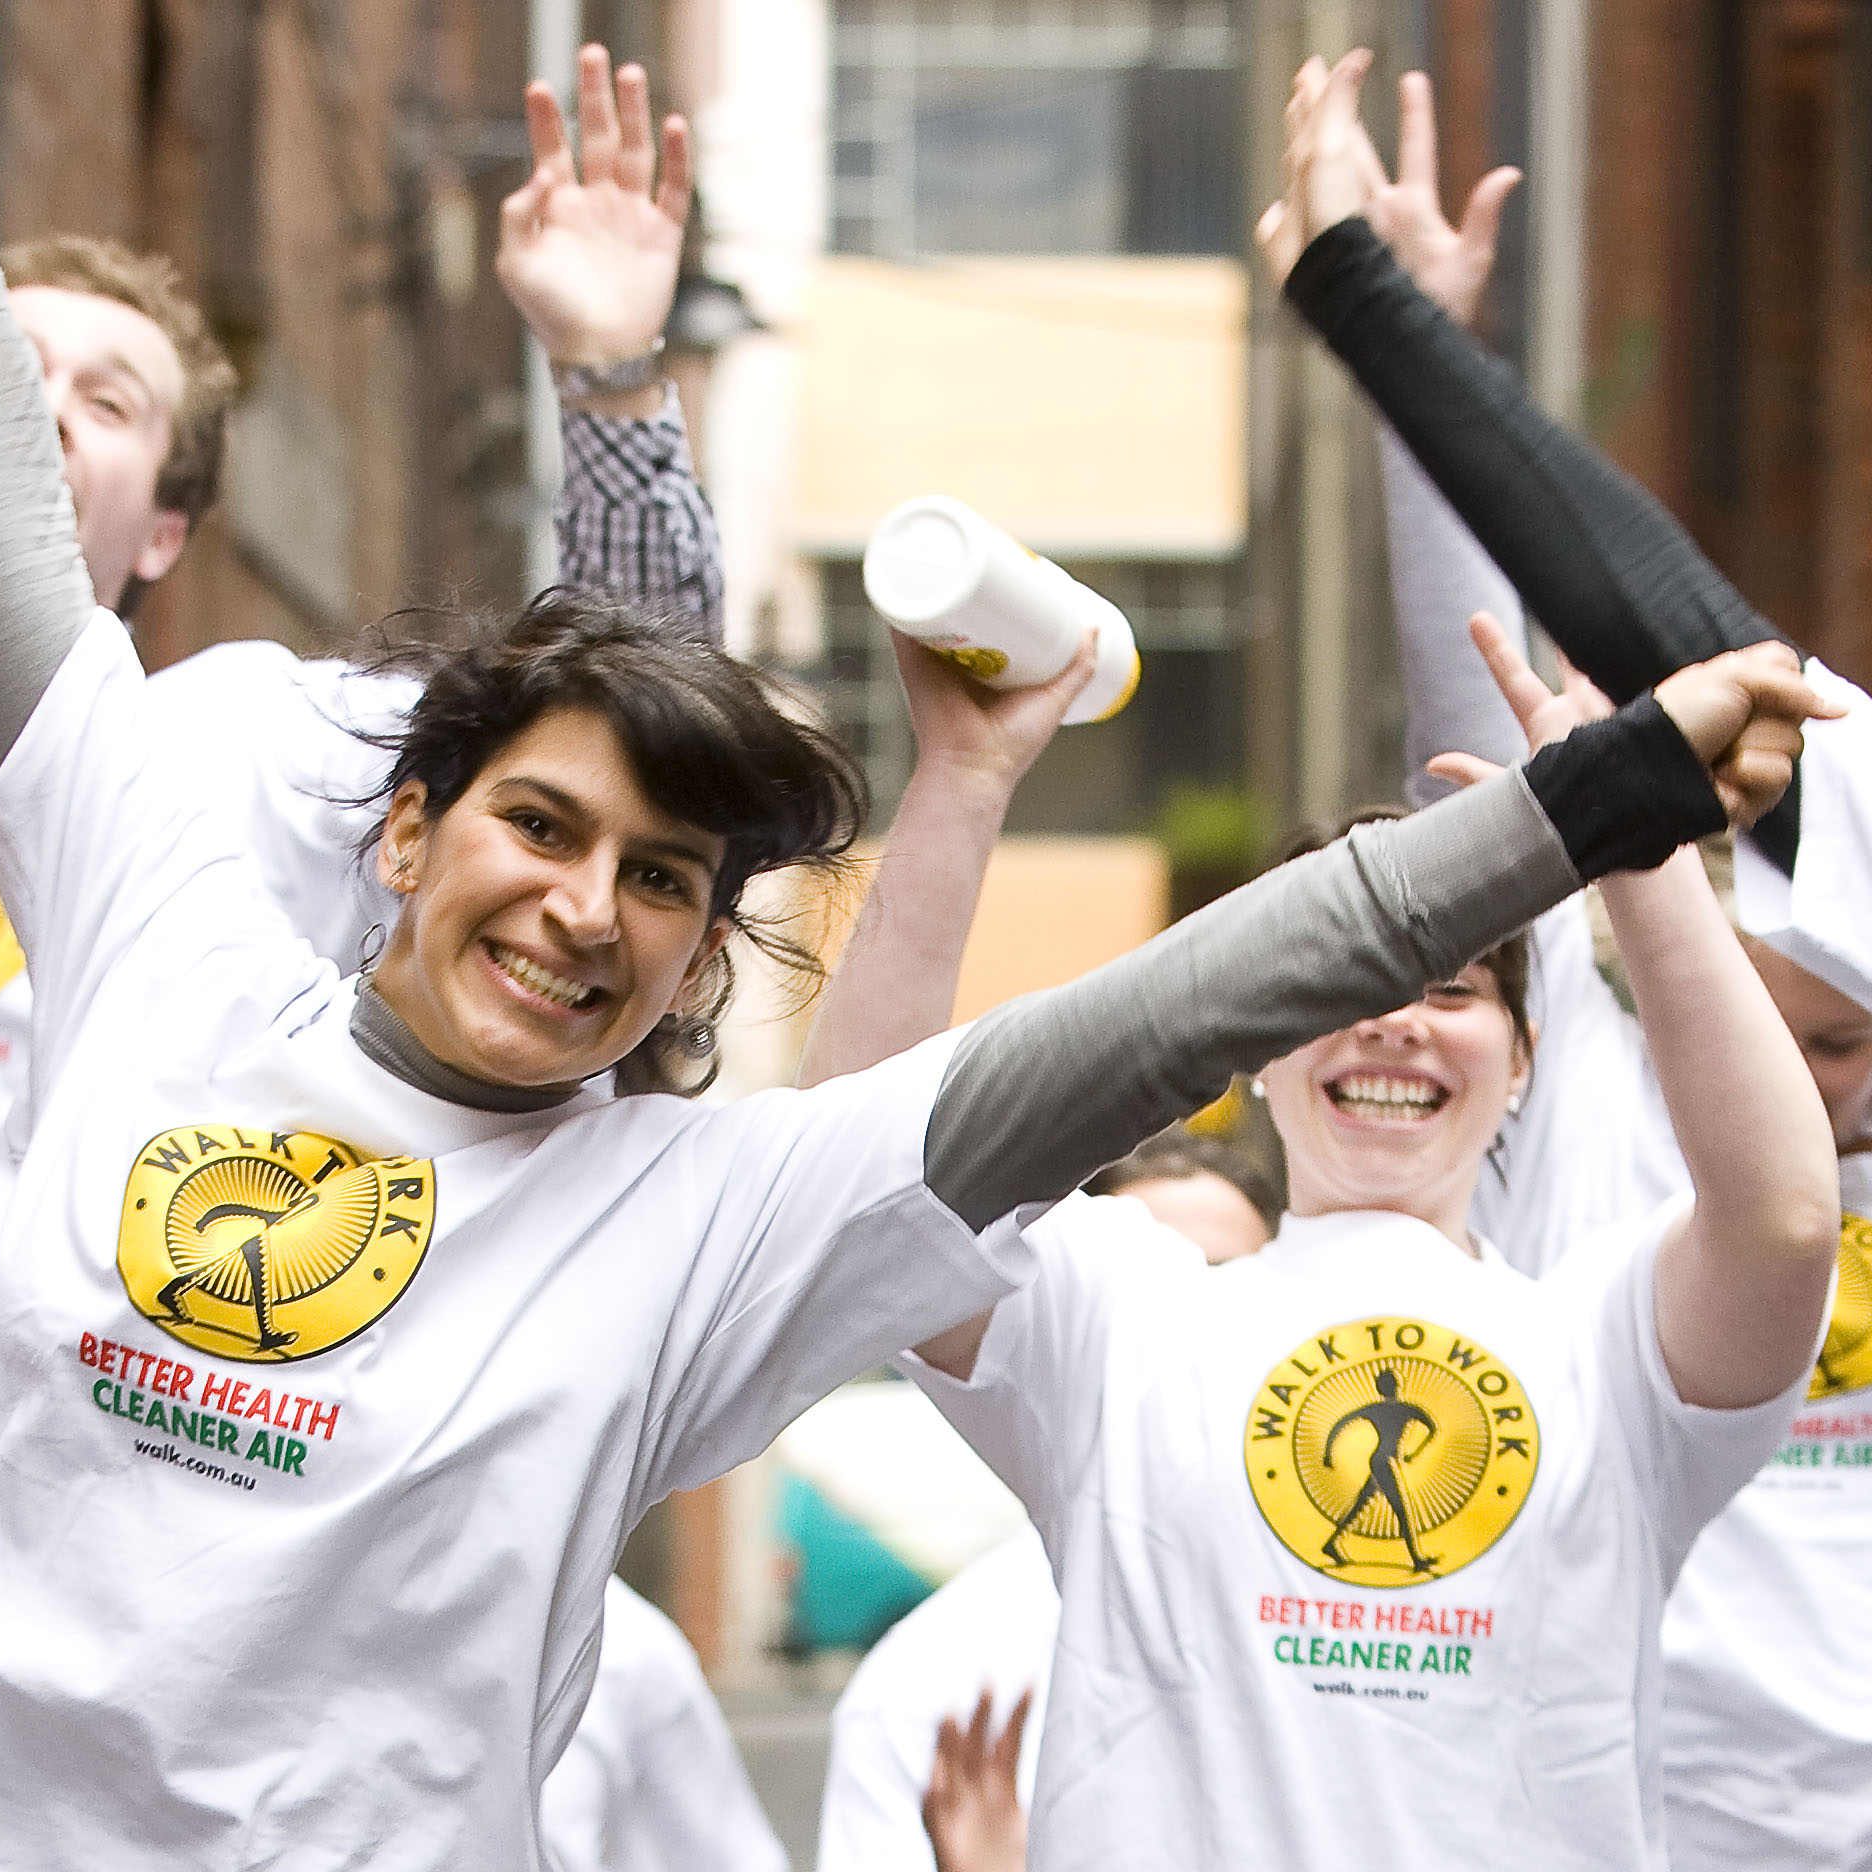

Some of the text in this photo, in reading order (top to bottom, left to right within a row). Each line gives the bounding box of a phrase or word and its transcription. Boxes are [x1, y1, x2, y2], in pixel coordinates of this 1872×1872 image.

[143, 1127, 299, 1174] WALK
[79, 1331, 341, 1441] BETTER HEALTH
[1253, 1323, 1530, 1462] WALK TO WORK
[93, 1379, 308, 1477] CLEANER AIR
[133, 1438, 257, 1492] walk.com.au
[1259, 1595, 1495, 1639] BETTER HEALTH
[1274, 1635, 1474, 1676] CLEANER AIR
